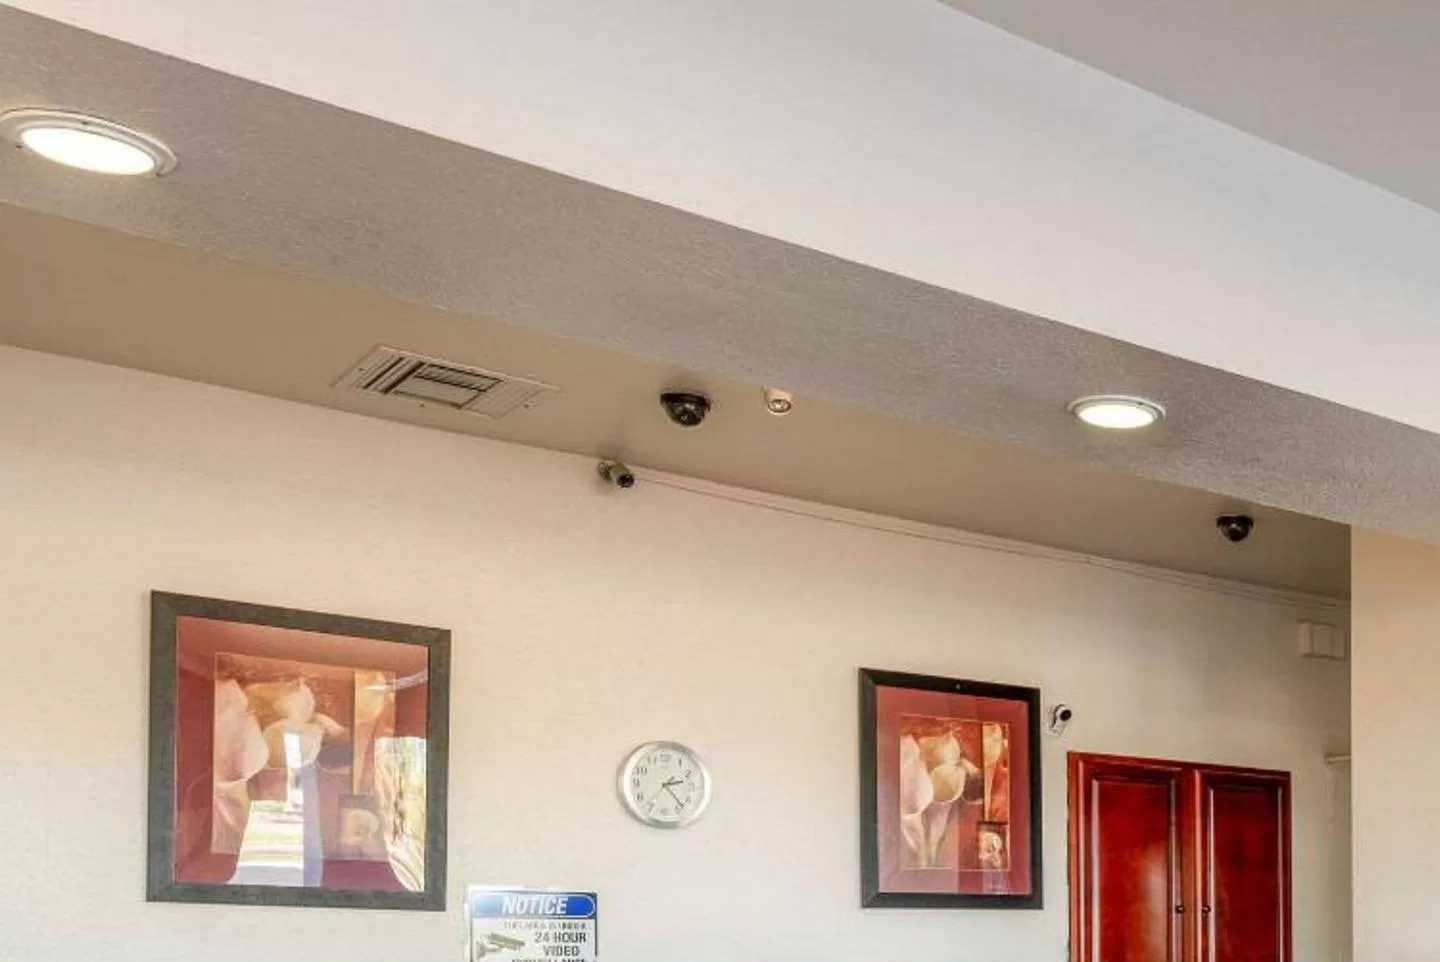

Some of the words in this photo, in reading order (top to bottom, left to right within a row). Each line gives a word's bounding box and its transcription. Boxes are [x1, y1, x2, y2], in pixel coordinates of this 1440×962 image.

[501, 896, 569, 915] NOTICE
[554, 932, 587, 943] HOUR
[543, 946, 580, 956] VIDEO
